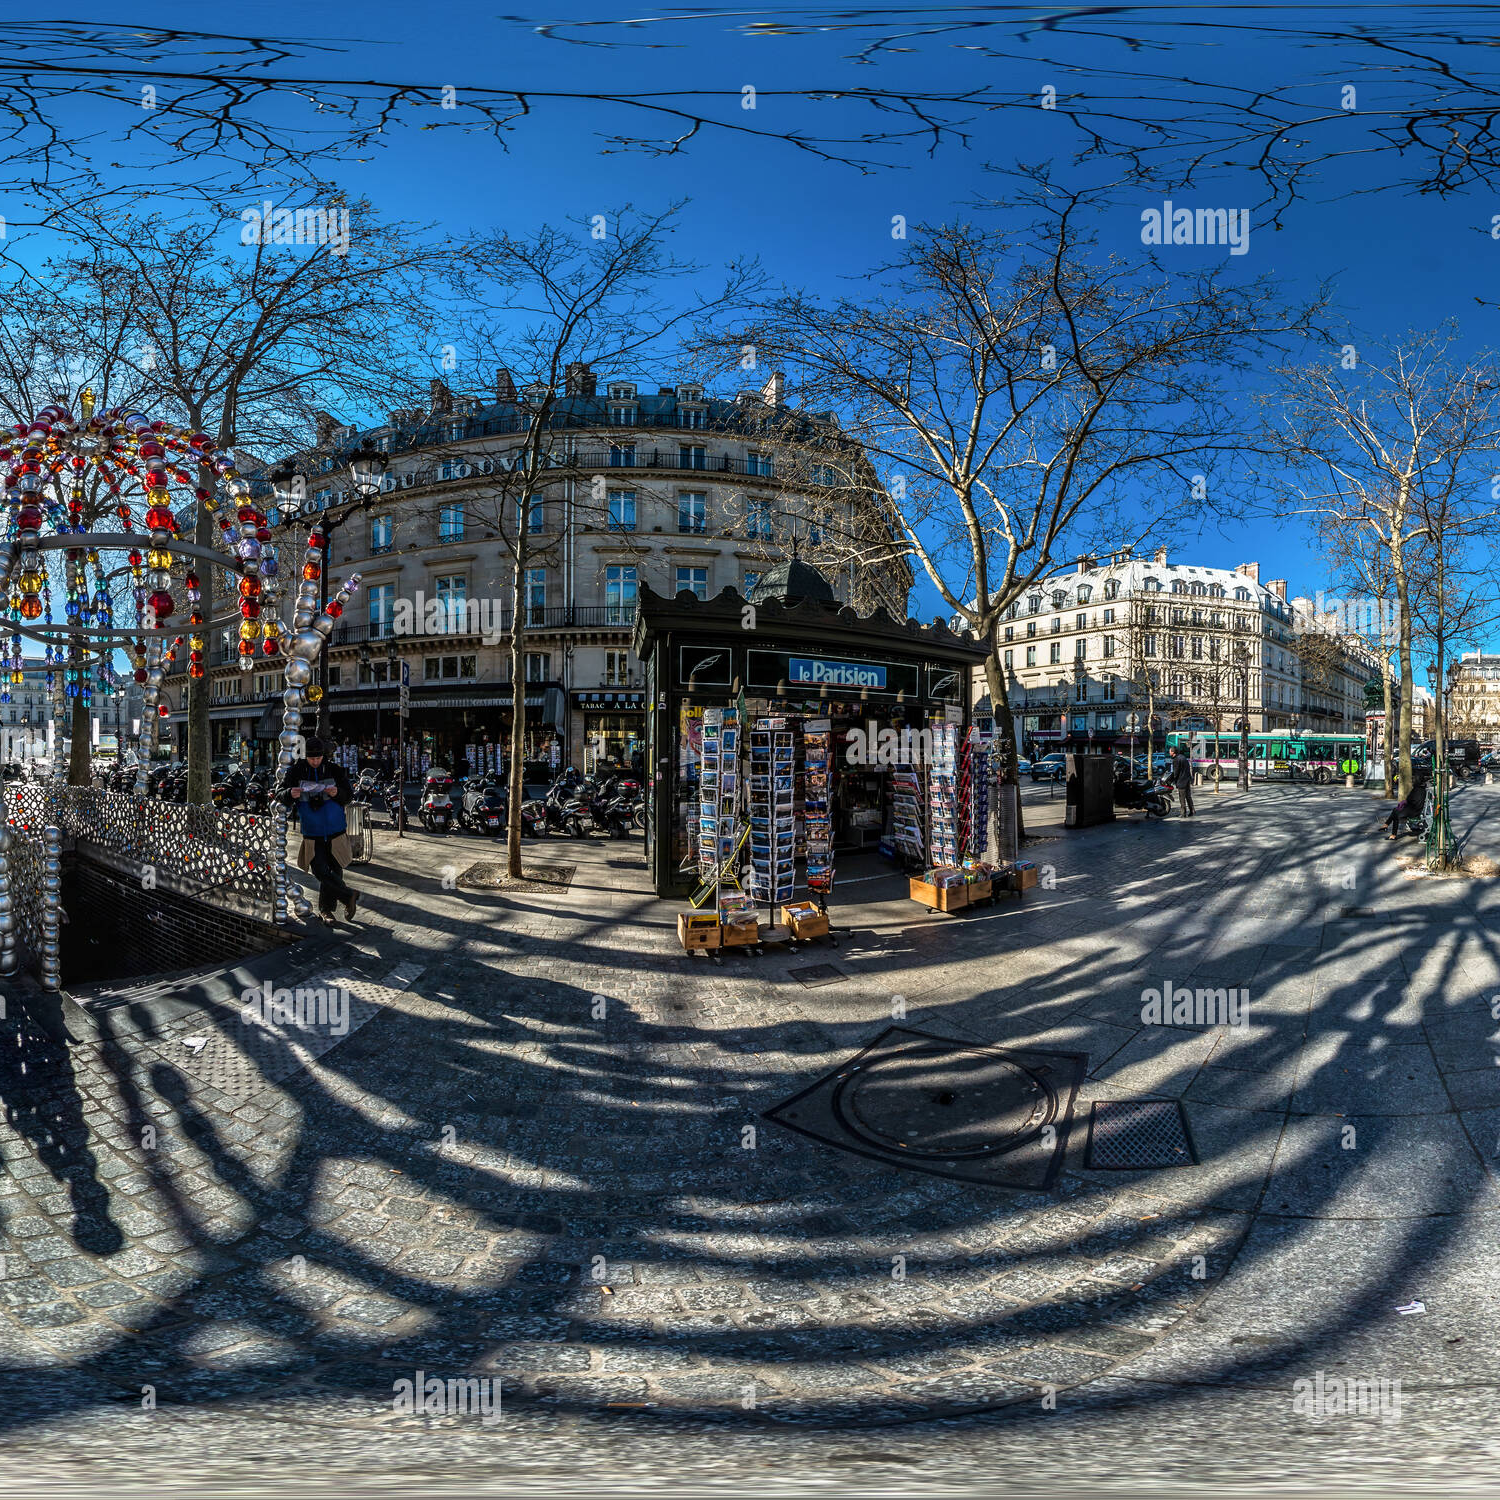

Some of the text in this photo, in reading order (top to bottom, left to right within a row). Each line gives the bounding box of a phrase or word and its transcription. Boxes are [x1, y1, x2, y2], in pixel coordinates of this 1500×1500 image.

[381, 471, 415, 493] DU
[799, 661, 879, 687] le Parisien
[581, 702, 605, 710] TABAC
[614, 701, 621, 709] A
